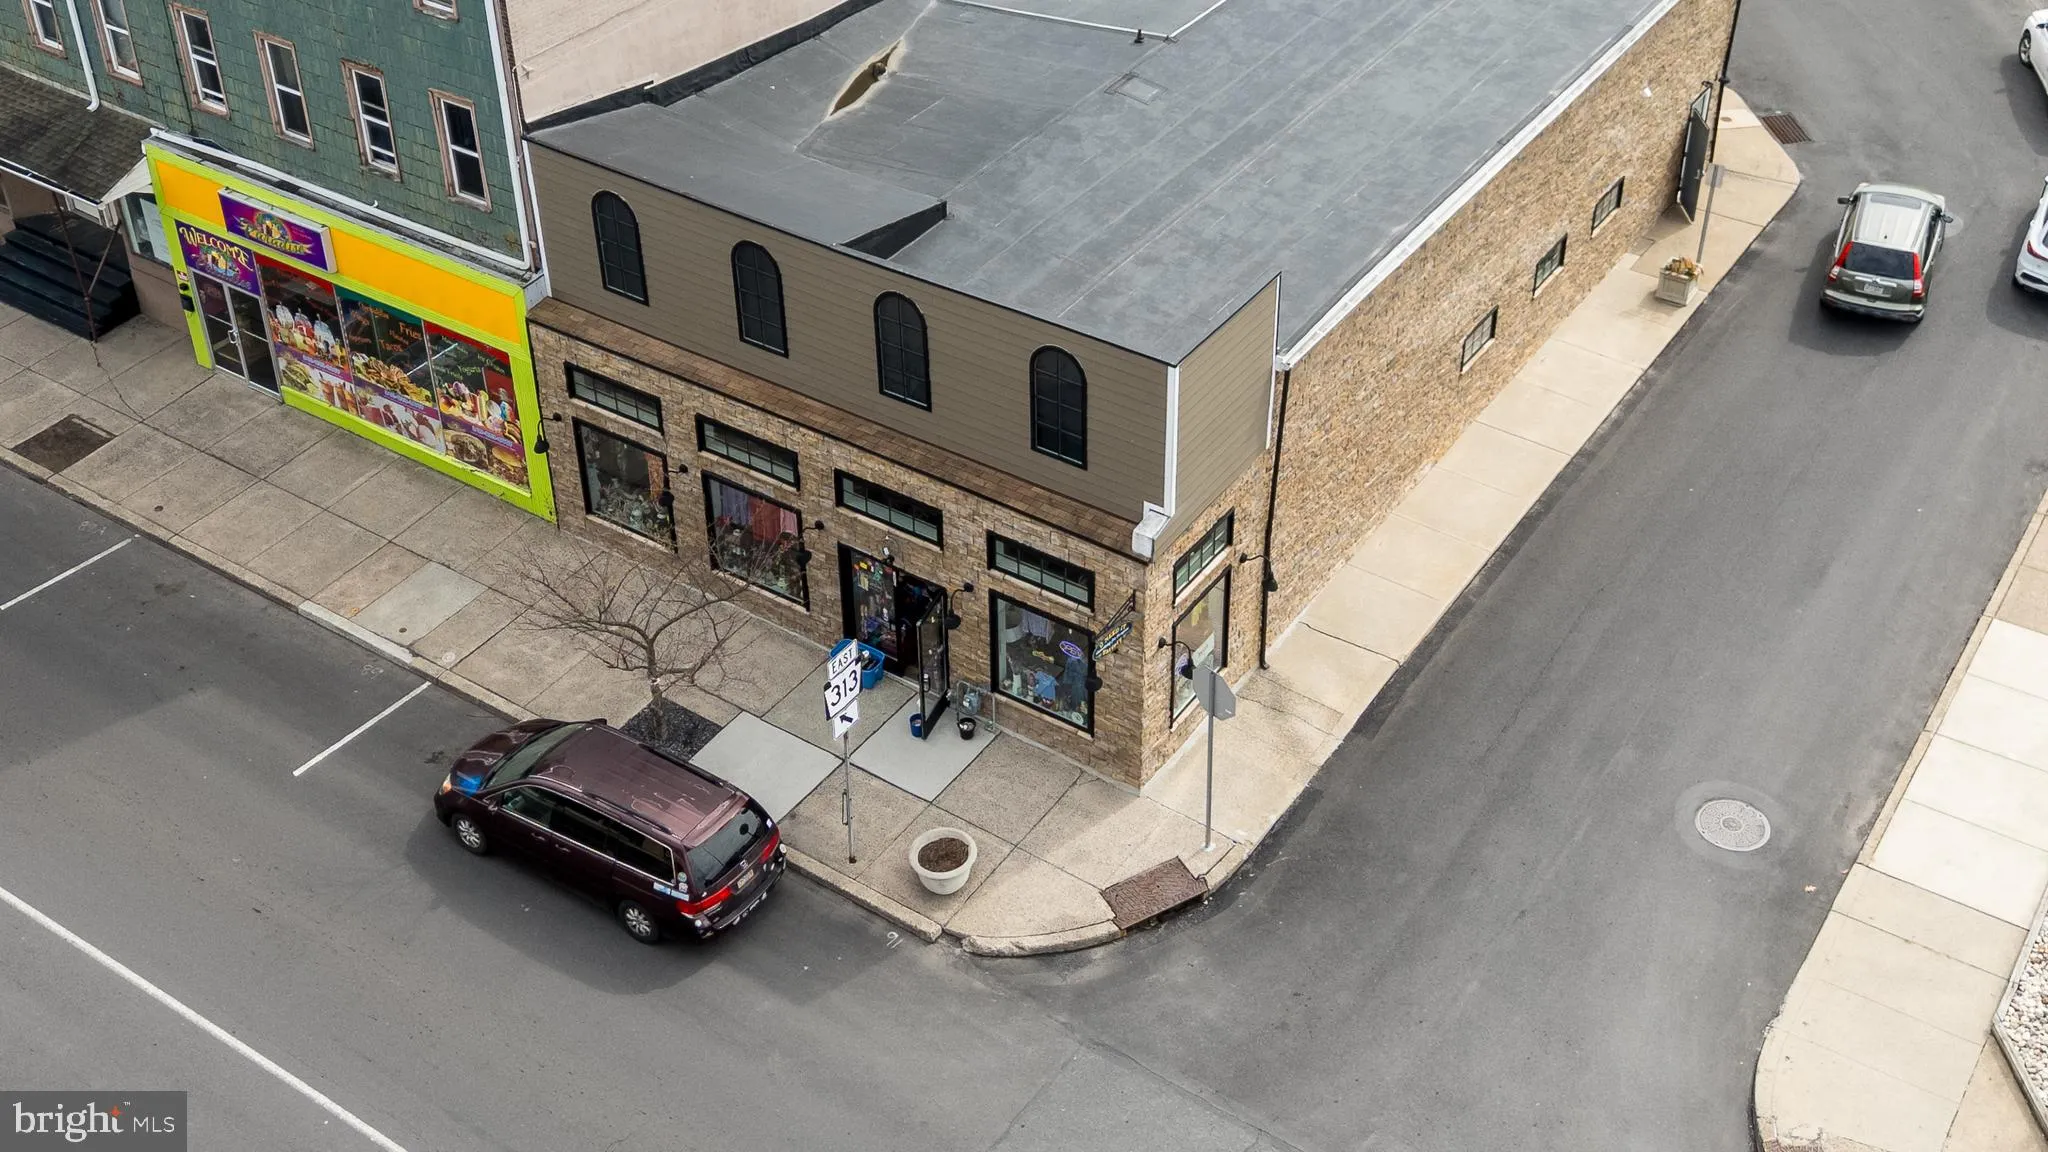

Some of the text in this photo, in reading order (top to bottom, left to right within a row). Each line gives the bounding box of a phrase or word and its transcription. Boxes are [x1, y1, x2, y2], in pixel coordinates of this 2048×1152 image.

[179, 226, 254, 272] WELCOME
[831, 648, 854, 674] EAST
[830, 669, 858, 707] 313
